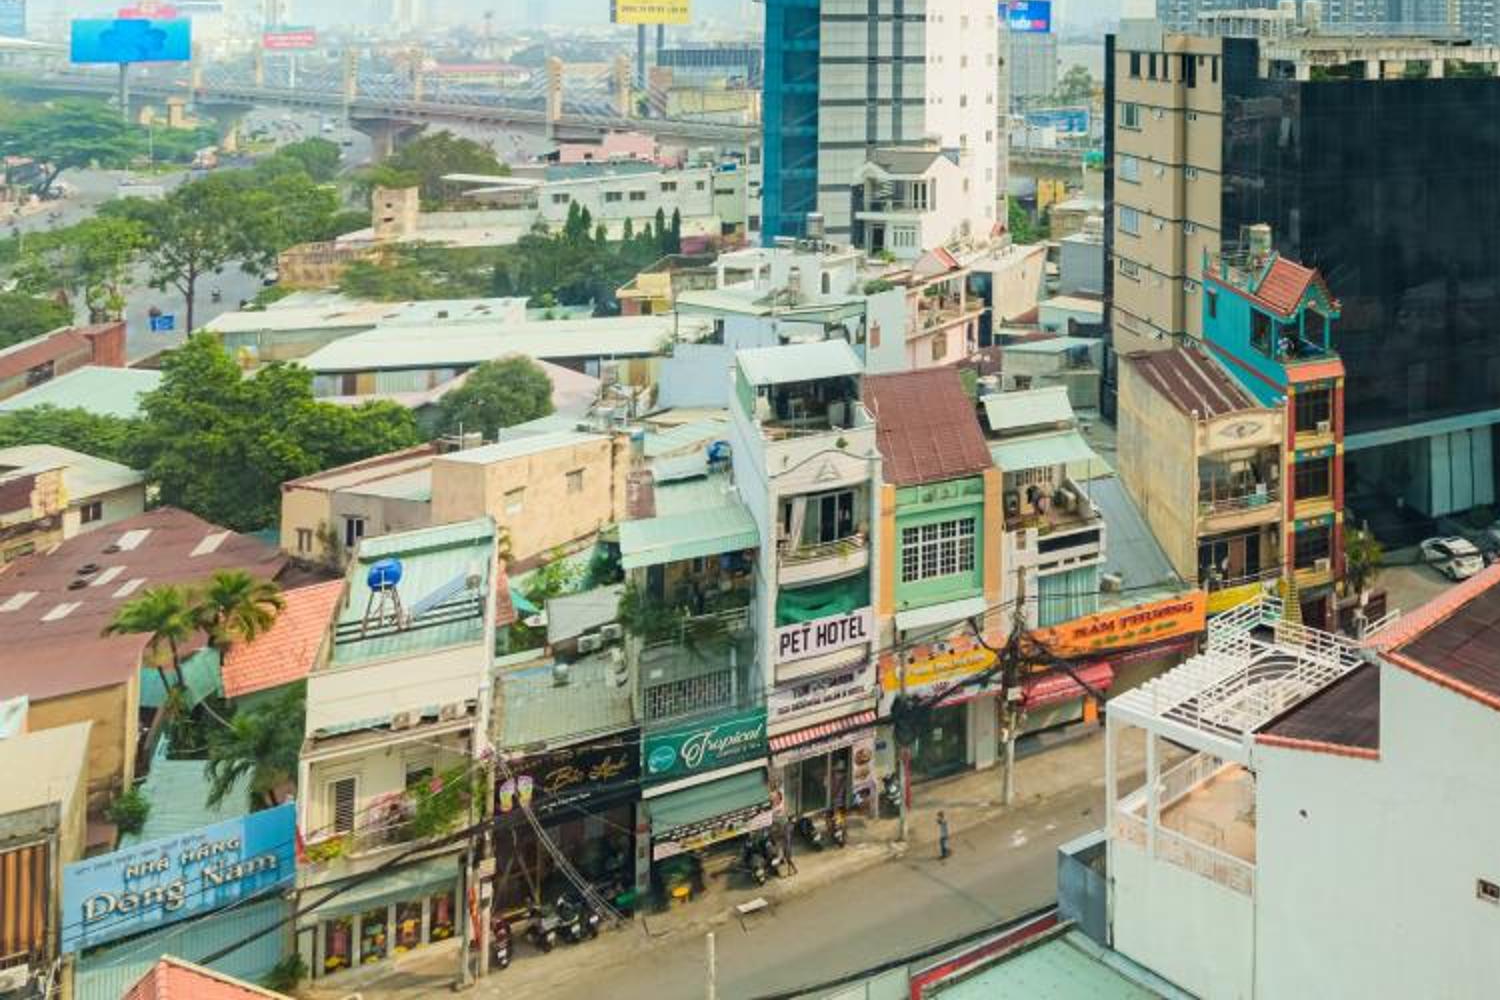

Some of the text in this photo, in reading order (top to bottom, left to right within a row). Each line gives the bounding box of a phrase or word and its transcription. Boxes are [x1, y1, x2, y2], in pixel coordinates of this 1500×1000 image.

[780, 616, 867, 657] PET HOTEL
[681, 723, 764, 769] Tropical
